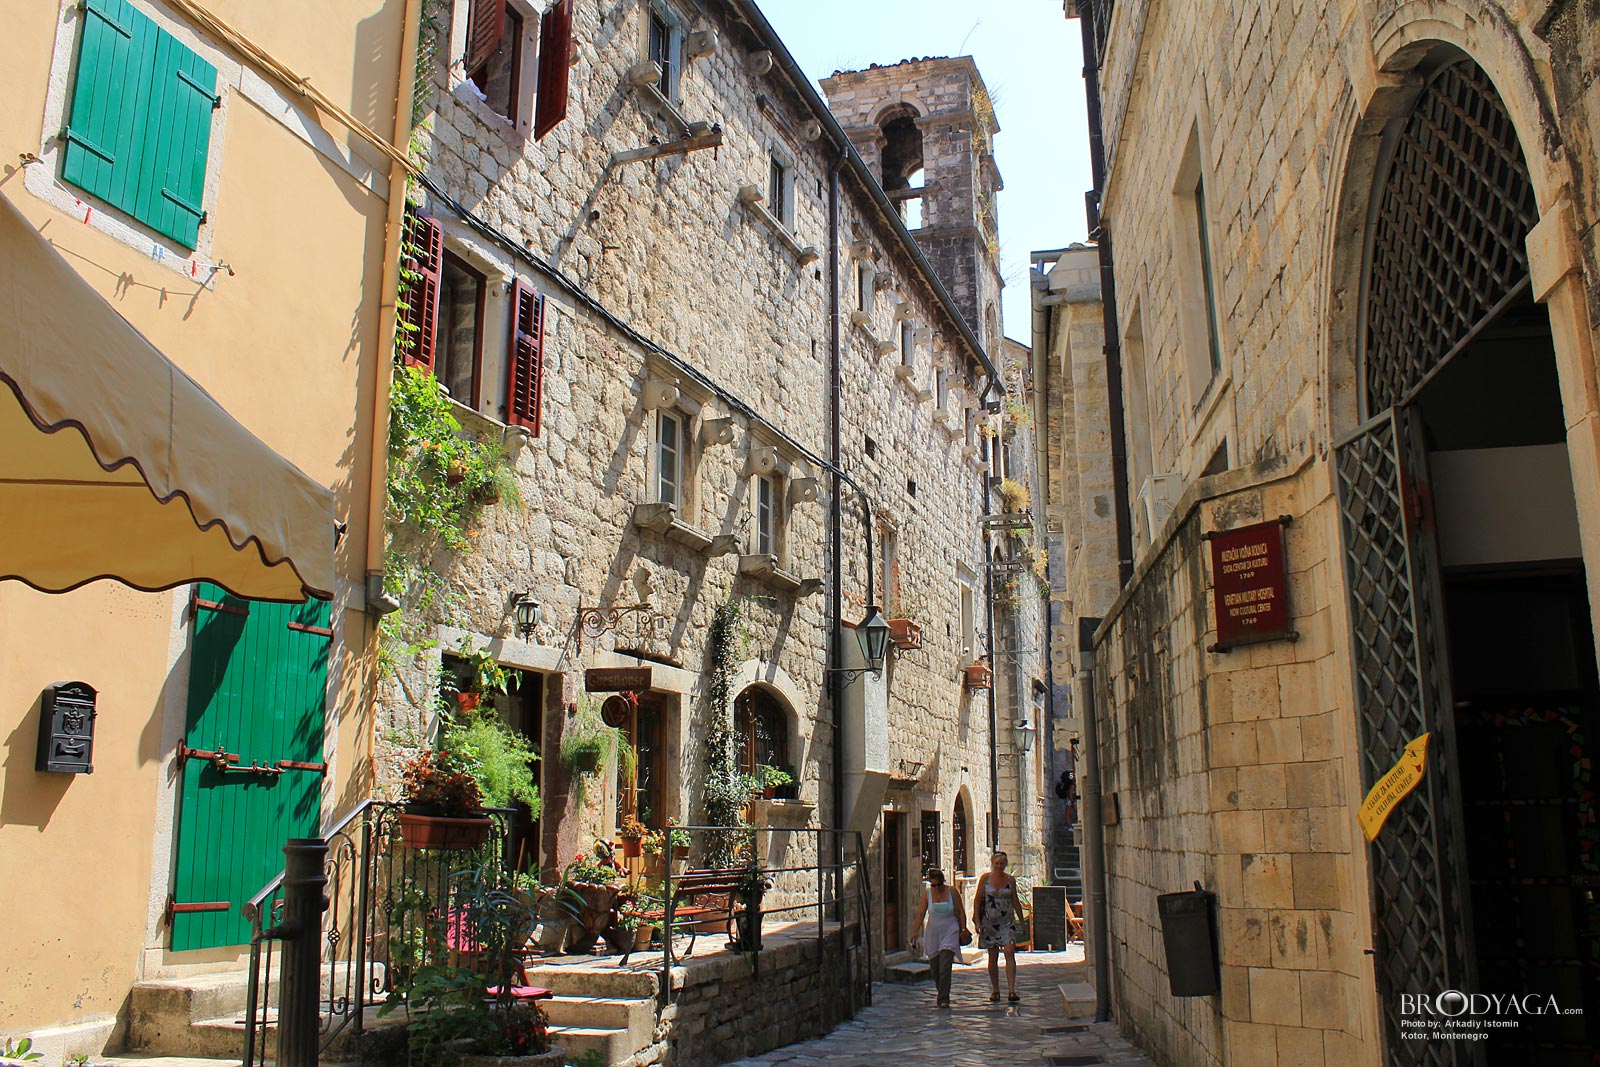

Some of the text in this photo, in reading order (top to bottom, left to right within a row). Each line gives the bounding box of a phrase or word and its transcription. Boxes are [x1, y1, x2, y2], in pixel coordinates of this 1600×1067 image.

[1251, 544, 1267, 556] BOLNICA
[1223, 564, 1233, 573] SADA
[1233, 561, 1246, 571] CENTAR
[1252, 557, 1268, 567] KULTURU
[1240, 571, 1255, 580] 1769
[1224, 586, 1274, 606] VENETIAN MILITARY HOSPITAL
[1230, 602, 1271, 616] NOW CULTURAL CENTER
[1242, 617, 1257, 625] 1769
[1380, 785, 1387, 796] ZA
[1386, 765, 1405, 789] KULTURU
[1376, 773, 1414, 815] CULTURAL CENTER
